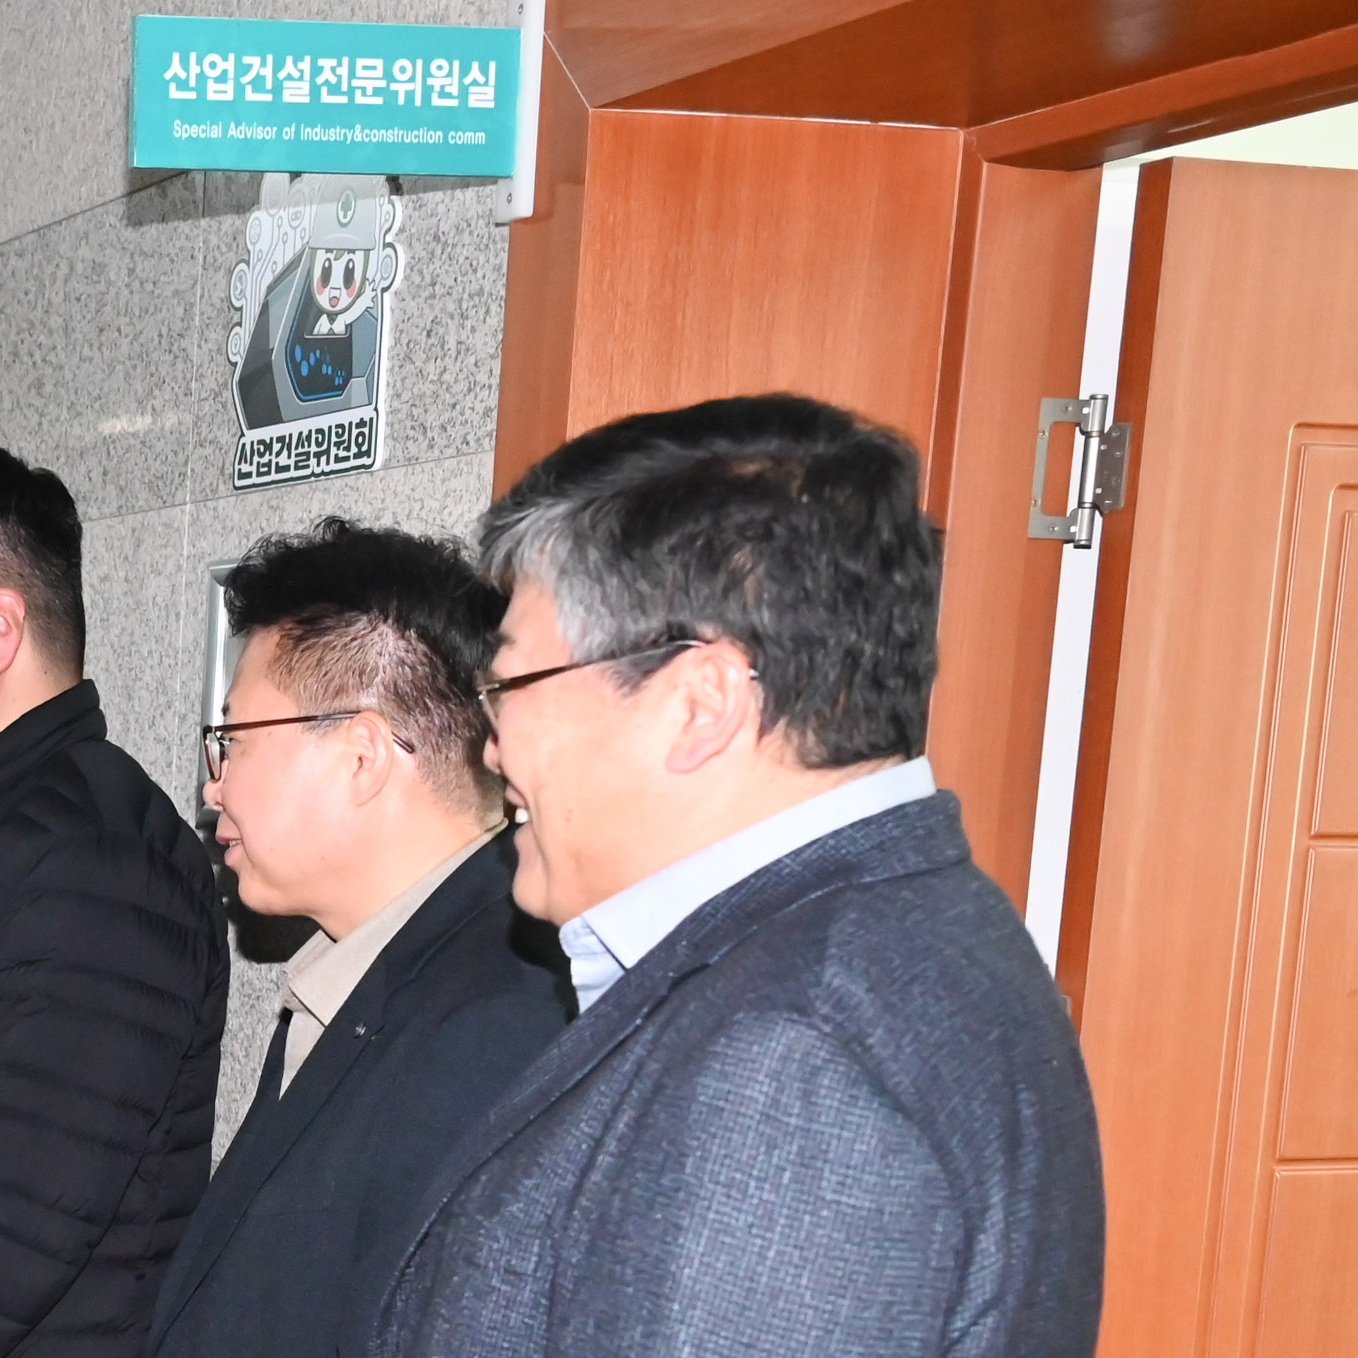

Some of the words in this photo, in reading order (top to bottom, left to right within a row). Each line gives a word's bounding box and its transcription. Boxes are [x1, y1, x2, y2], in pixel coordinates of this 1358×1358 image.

[163, 51, 497, 109] 산업건설전문위원실
[172, 120, 222, 140] Special
[227, 122, 277, 141] Advisor
[282, 123, 296, 141] of
[300, 124, 443, 145] Industry&construction
[448, 131, 486, 146] comm
[236, 416, 375, 480] 산업건설위원회
